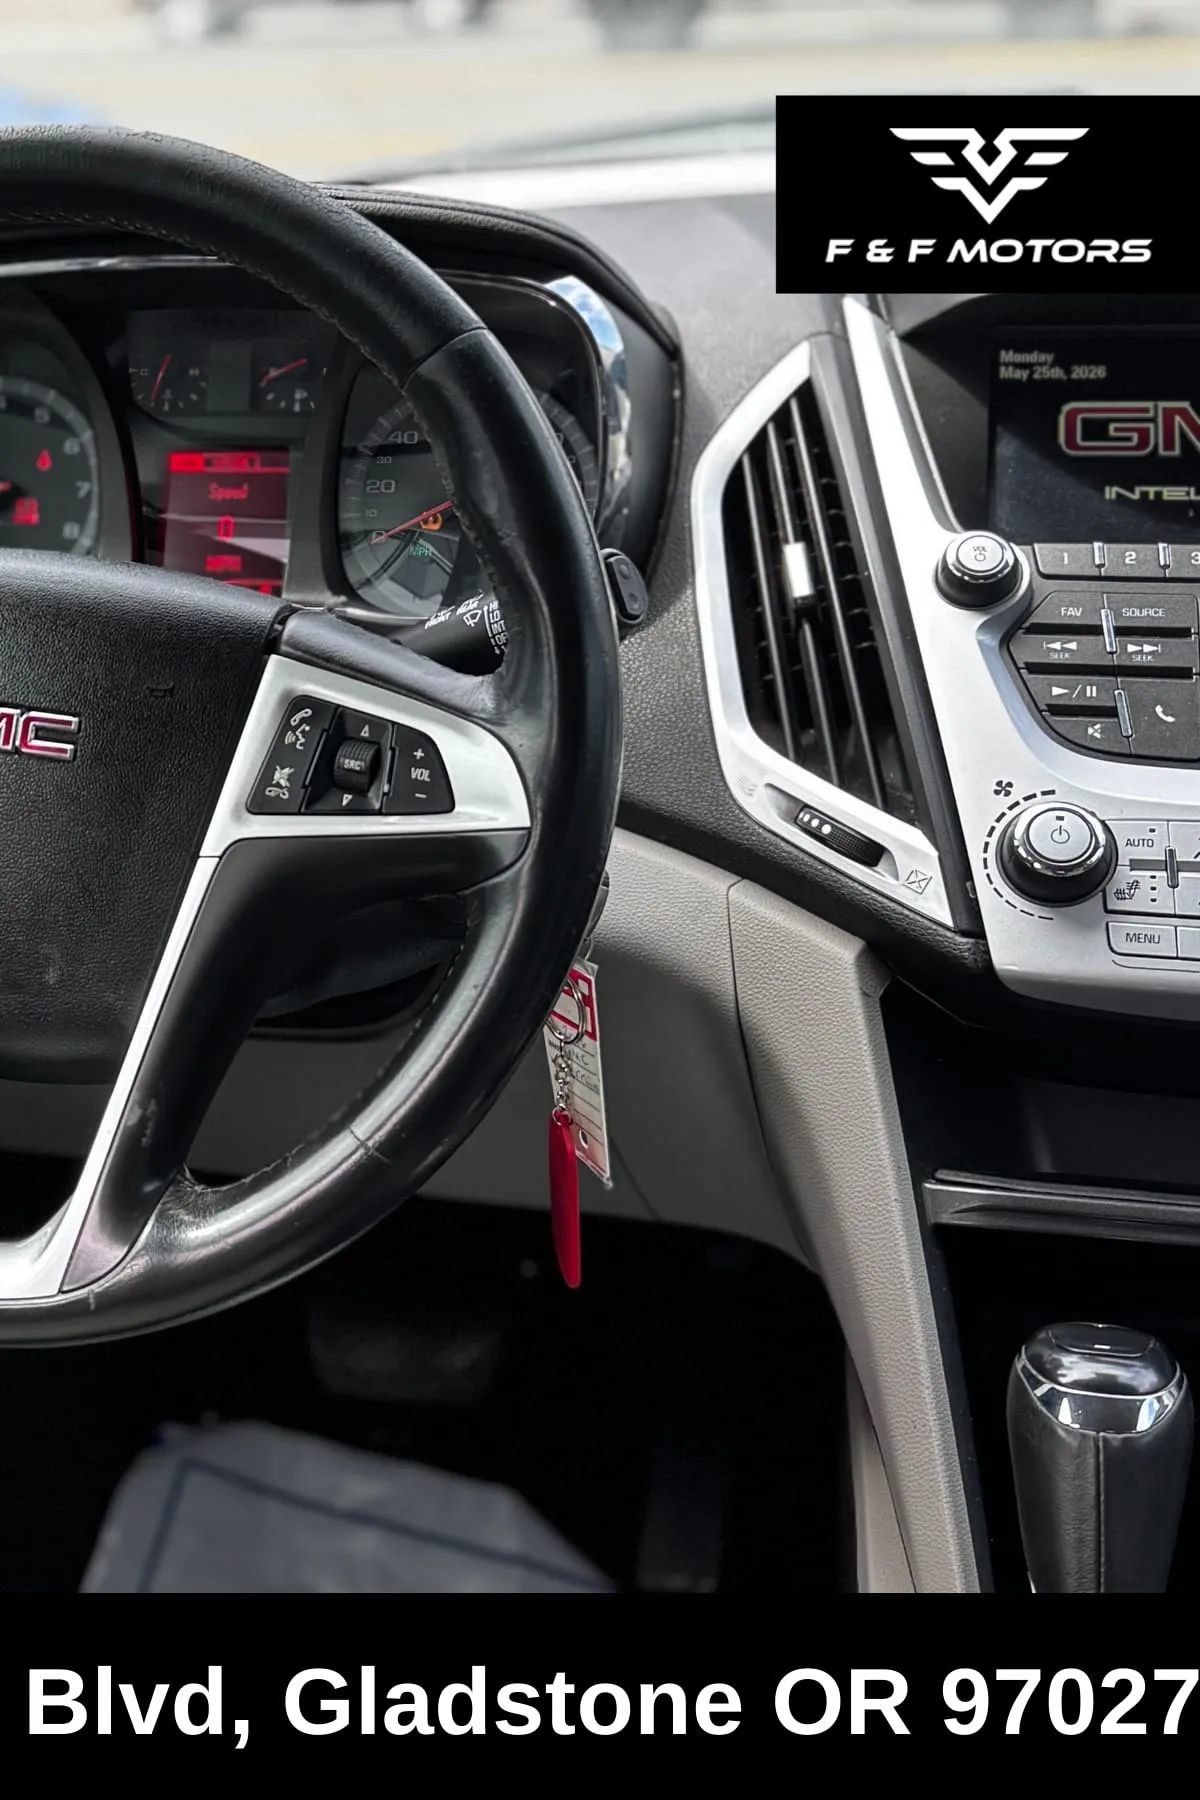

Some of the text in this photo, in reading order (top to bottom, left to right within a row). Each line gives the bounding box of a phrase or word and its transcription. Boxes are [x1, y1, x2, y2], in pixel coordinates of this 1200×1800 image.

[1000, 350, 1054, 366] Monday
[1000, 365, 1107, 381] May 25th, 2026
[388, 431, 419, 444] 40
[376, 456, 392, 464] 30
[75, 480, 91, 498] 7
[366, 480, 396, 494] 20
[1063, 552, 1069, 565] 1
[1125, 551, 1137, 564] 2
[1191, 552, 1200, 565] 3
[490, 610, 500, 623] LO
[1061, 607, 1082, 617] FAV
[1122, 608, 1166, 617] SOURCE
[491, 620, 506, 634] INT
[495, 632, 508, 646] OF
[1050, 652, 1071, 660] SEEK
[410, 767, 431, 782] VOL
[1125, 838, 1154, 848] AUTO
[1125, 932, 1161, 944] MENU
